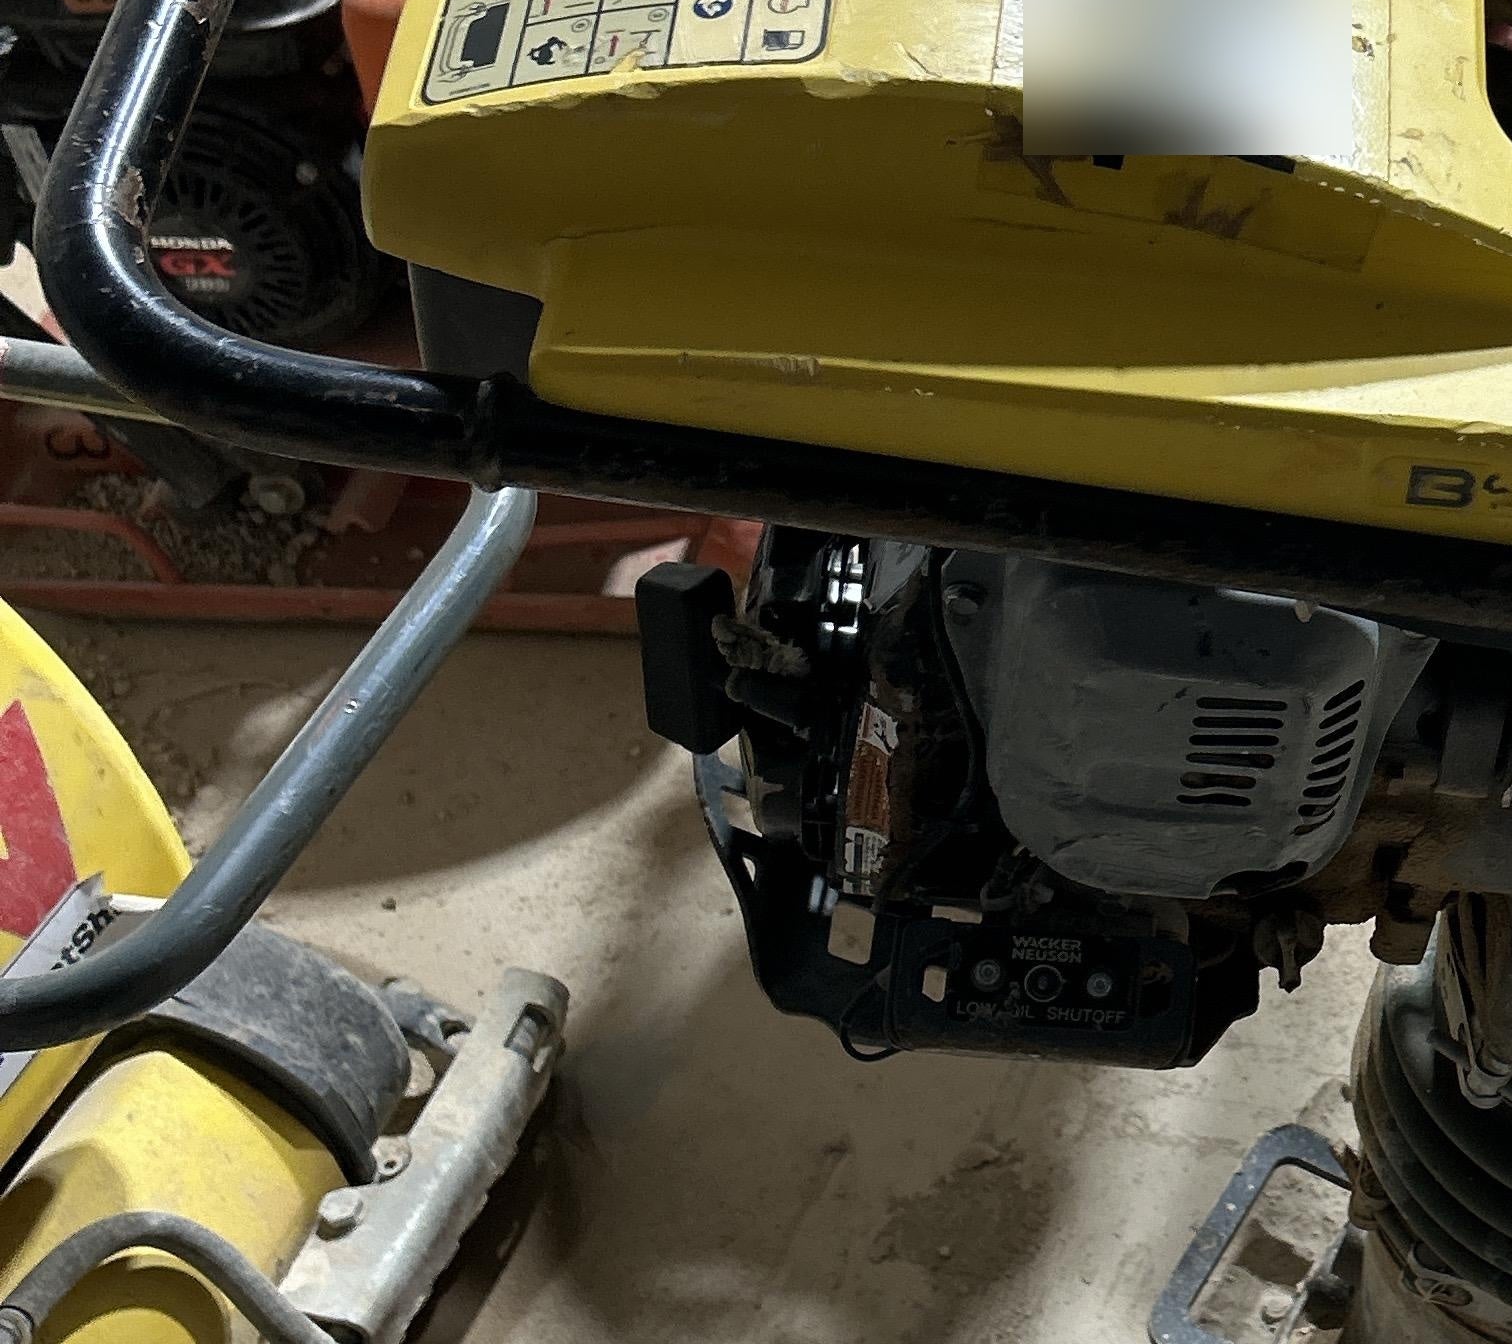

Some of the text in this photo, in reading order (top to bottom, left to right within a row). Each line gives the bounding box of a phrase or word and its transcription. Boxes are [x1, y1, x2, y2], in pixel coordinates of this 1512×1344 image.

[151, 237, 233, 250] HONDA
[160, 253, 236, 276] GX
[1013, 936, 1081, 951] WACKER
[1012, 948, 1082, 963] NEUSON
[1047, 1006, 1128, 1025] SHUTOFF
